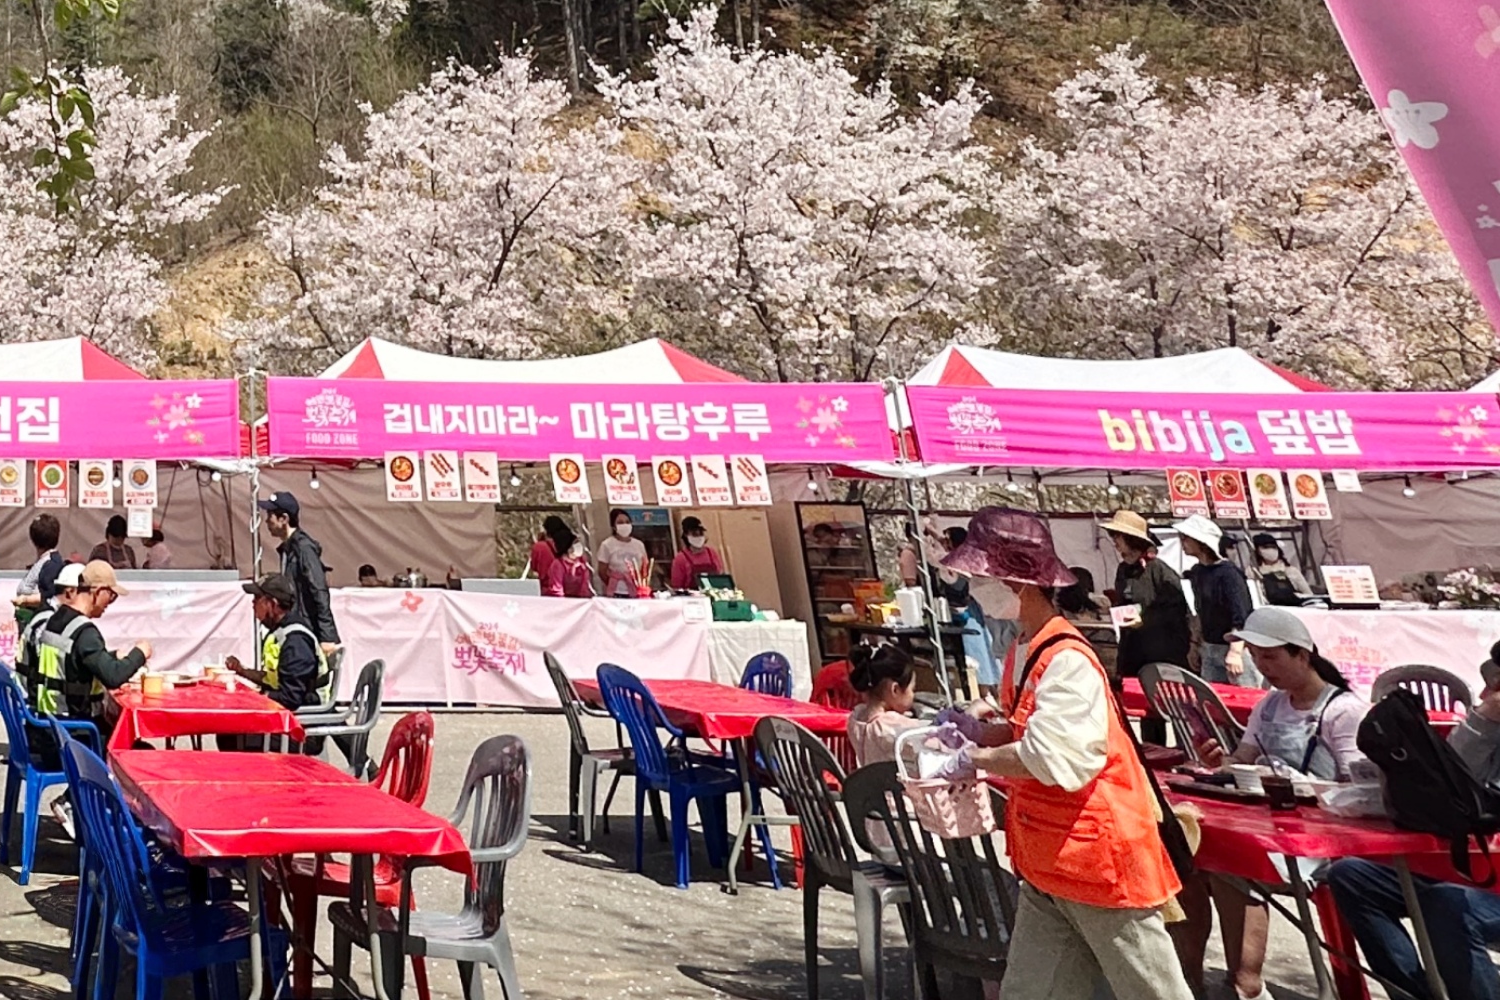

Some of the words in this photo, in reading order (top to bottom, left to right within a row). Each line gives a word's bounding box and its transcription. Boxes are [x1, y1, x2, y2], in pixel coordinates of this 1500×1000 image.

[305, 432, 331, 445] FOOD
[333, 433, 358, 445] ZONE
[383, 403, 560, 436] 겁내지마라~
[569, 402, 772, 442] 마라탕후루
[1097, 409, 1255, 462] bibija
[1257, 409, 1362, 456] 덮밥
